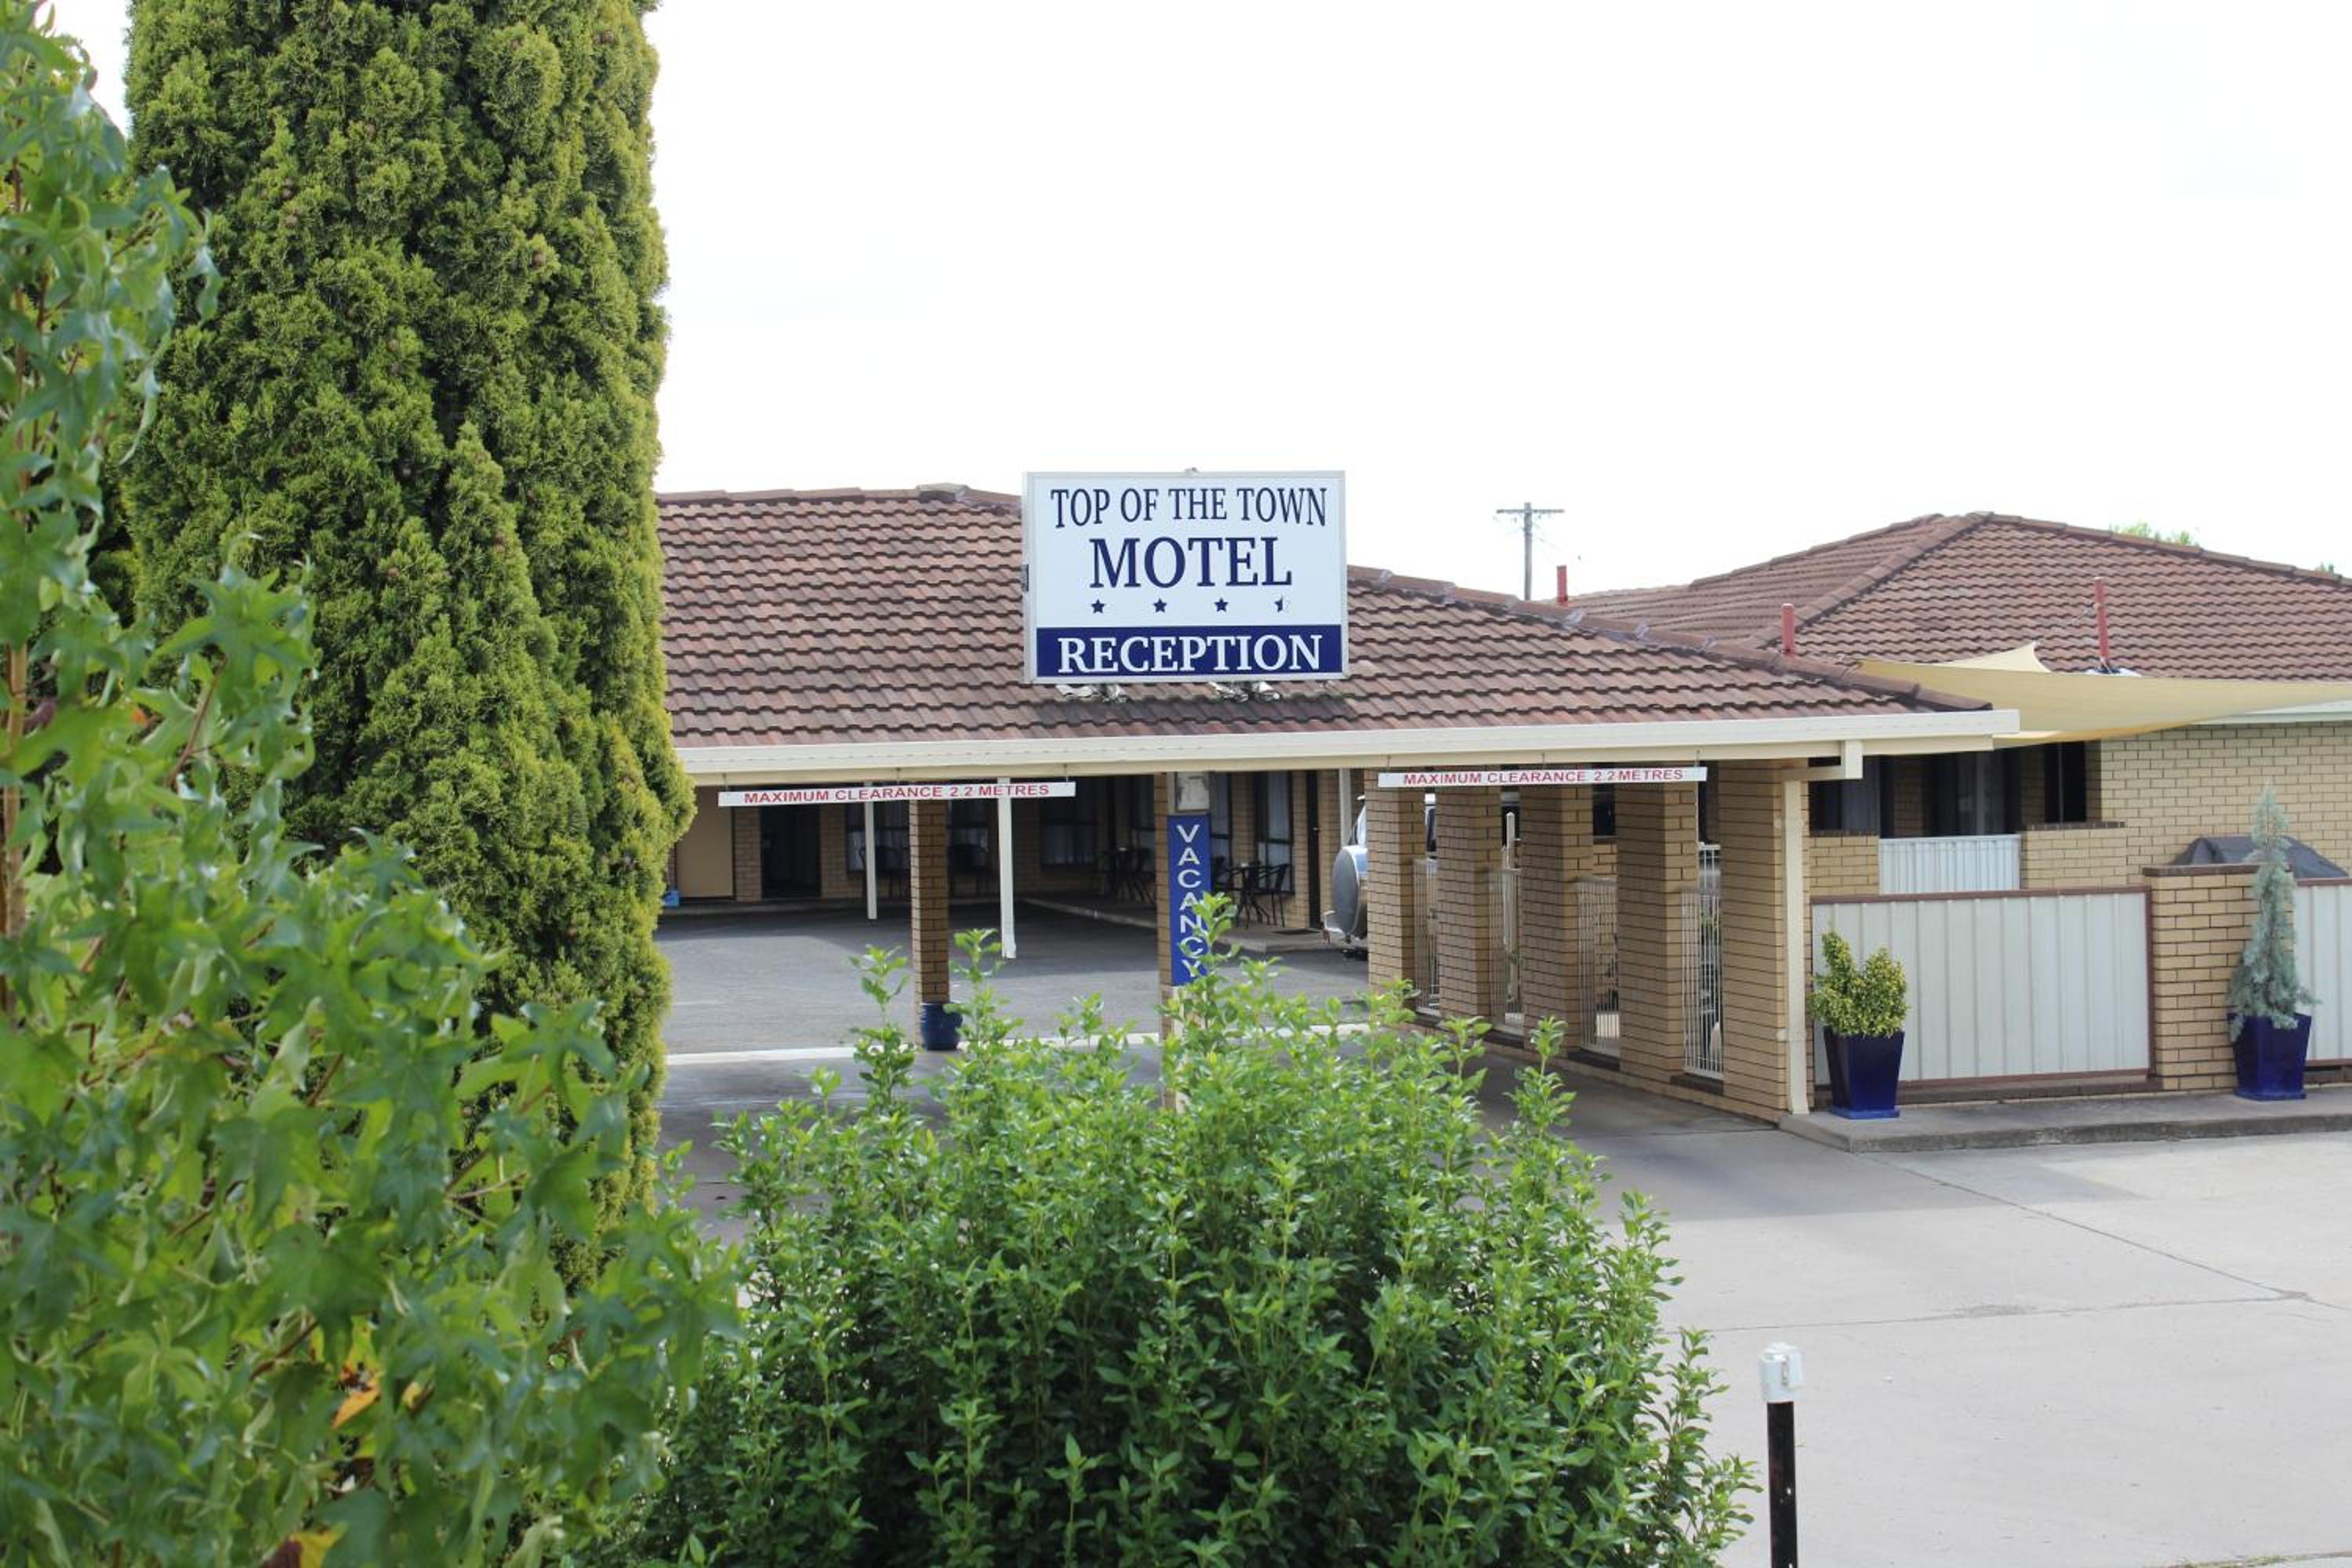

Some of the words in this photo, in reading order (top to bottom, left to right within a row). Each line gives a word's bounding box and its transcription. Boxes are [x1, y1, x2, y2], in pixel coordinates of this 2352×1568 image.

[1051, 489, 1110, 528] TOP
[1120, 488, 1159, 522] OF
[1168, 488, 1227, 521] THE
[1237, 487, 1327, 527] TOWN
[1089, 536, 1293, 589] MOTEL
[1057, 634, 1323, 674] RECEPTION
[743, 790, 829, 804] MAXIMUM
[835, 786, 942, 800] CLEARANCE
[949, 786, 973, 797] 2.2
[978, 784, 1050, 796] METRES
[1404, 773, 1481, 785] MAXIMUM
[1487, 770, 1584, 783] CLEARANCE
[1619, 769, 1683, 781] METRES
[1177, 824, 1208, 977] VACANCY
